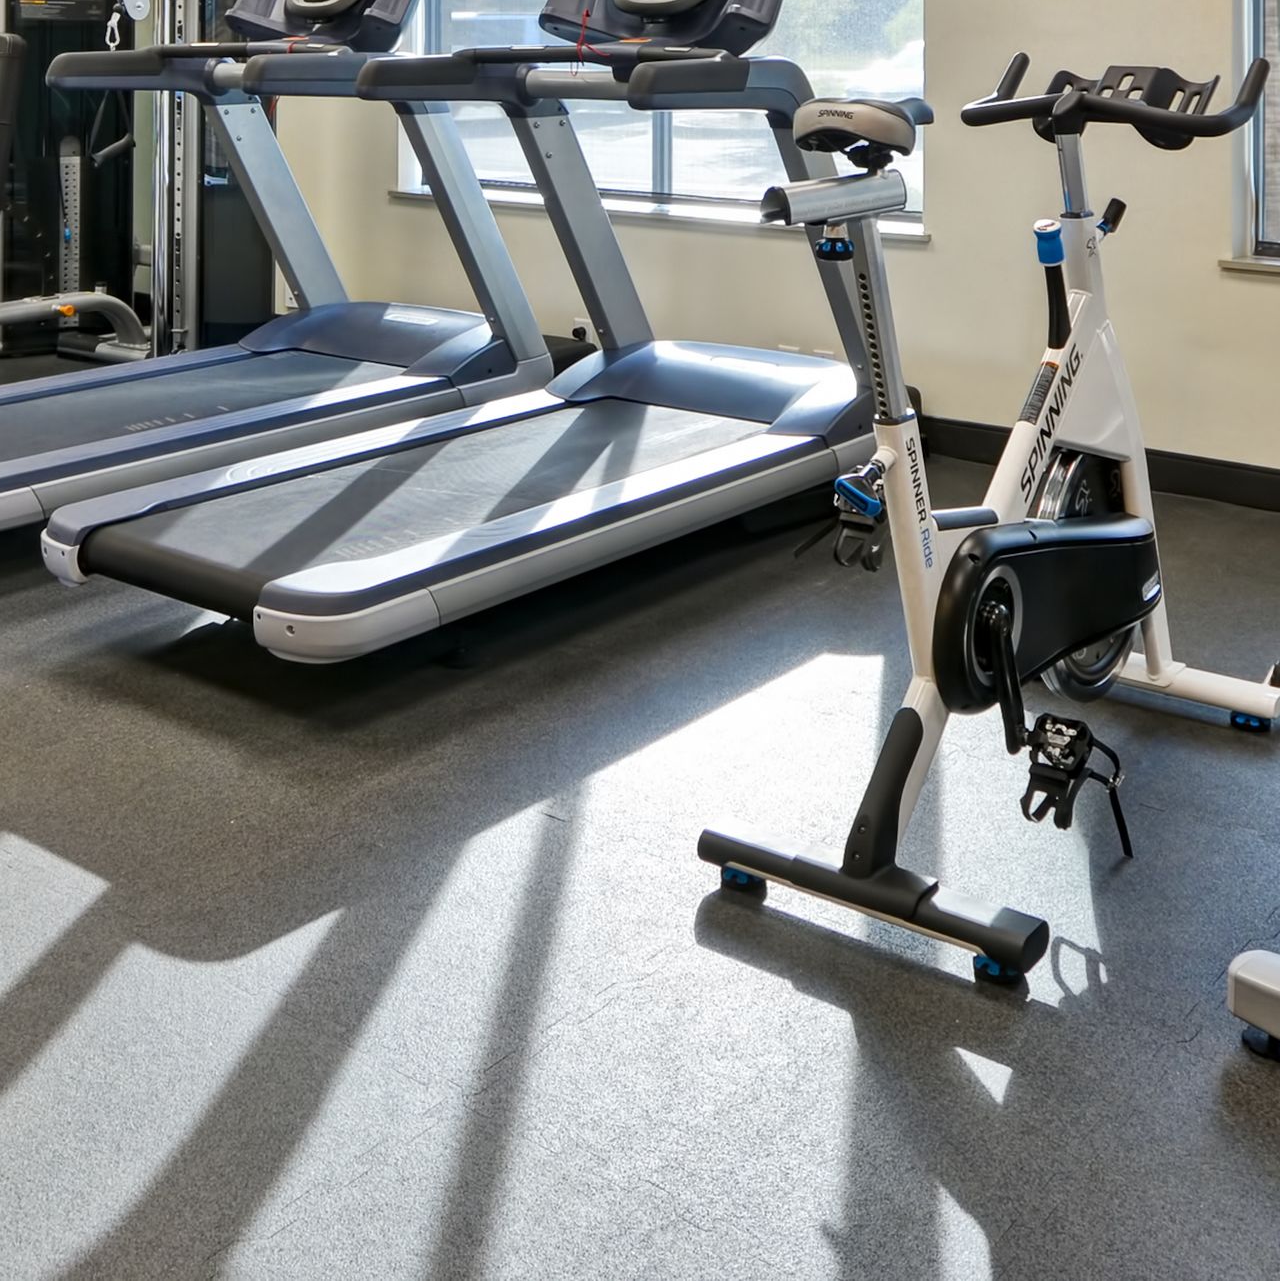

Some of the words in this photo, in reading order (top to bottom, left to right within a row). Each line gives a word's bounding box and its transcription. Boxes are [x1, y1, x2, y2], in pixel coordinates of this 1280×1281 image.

[817, 109, 855, 120] SPINNING
[905, 436, 927, 524] SPINNER
[920, 527, 934, 569] Ride
